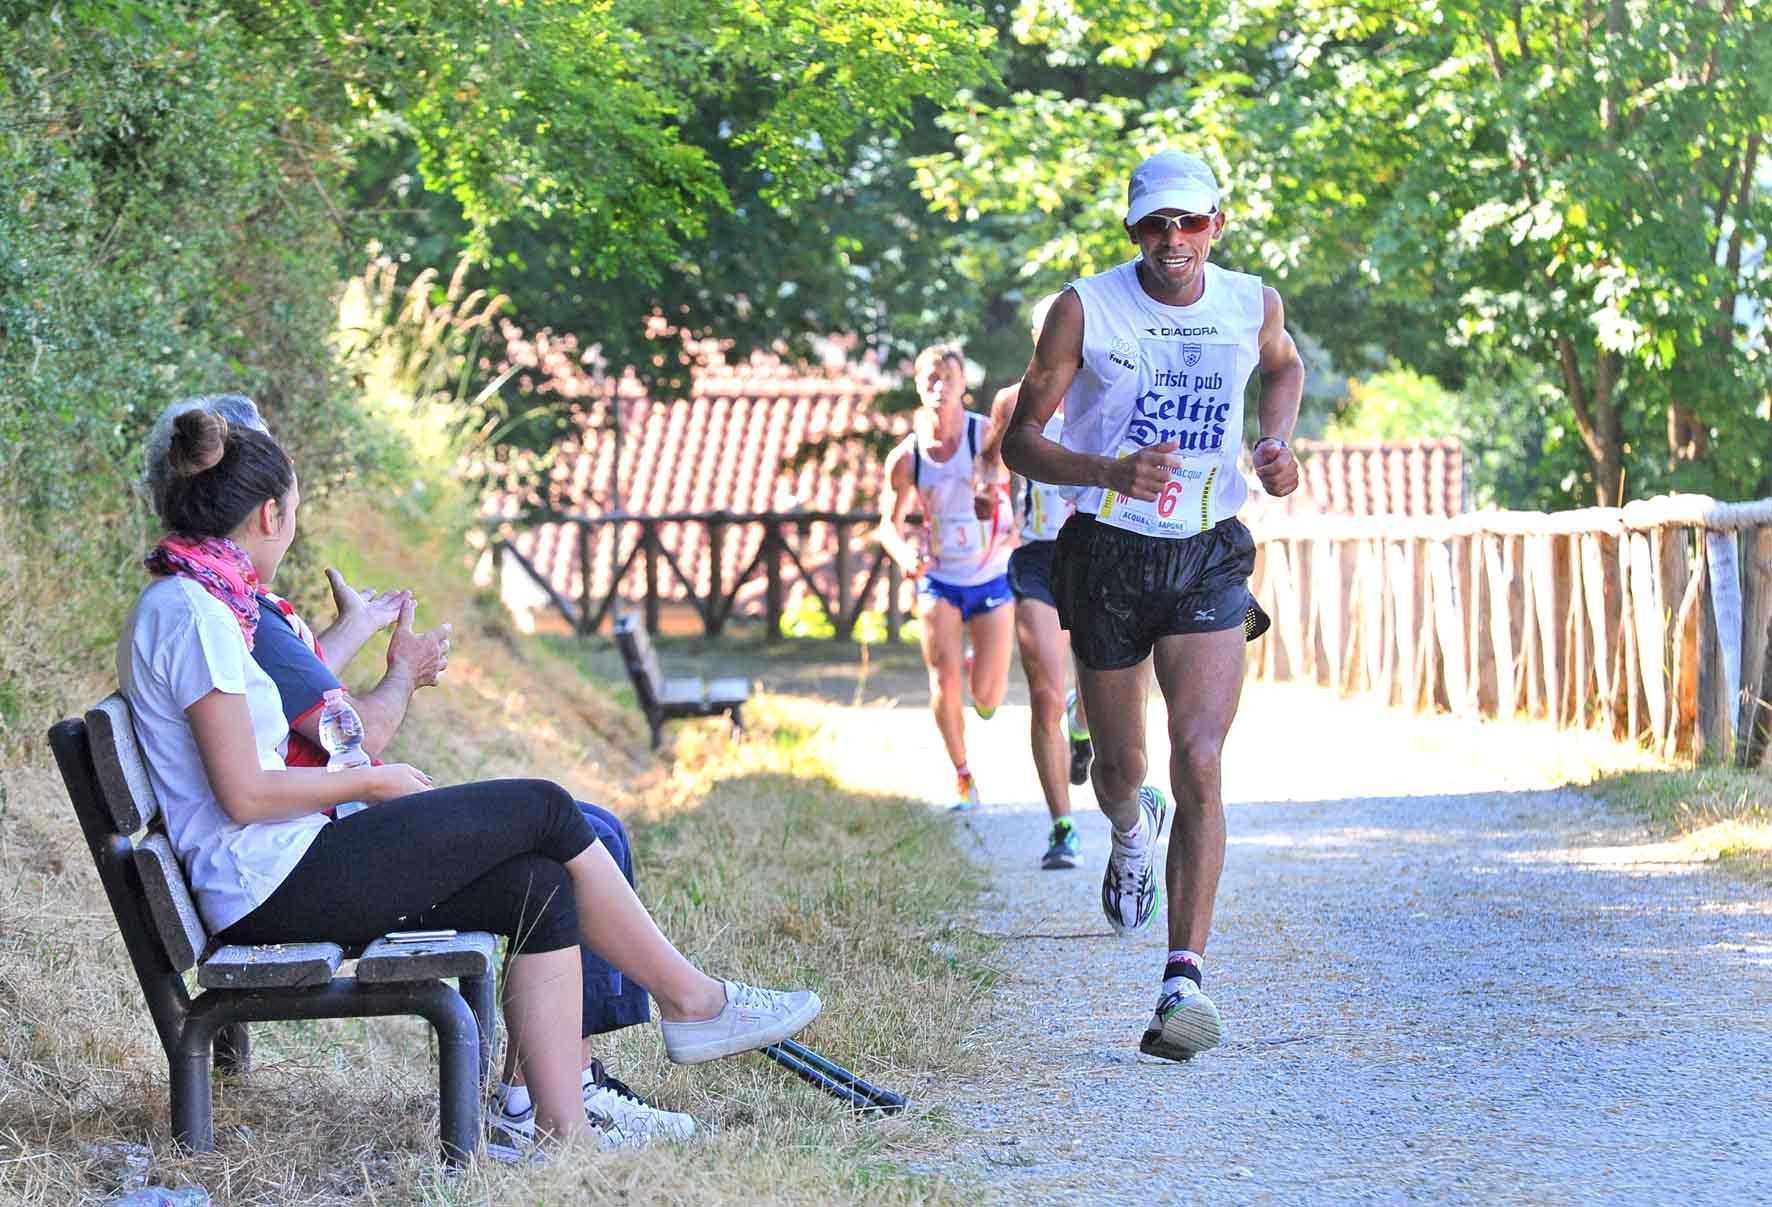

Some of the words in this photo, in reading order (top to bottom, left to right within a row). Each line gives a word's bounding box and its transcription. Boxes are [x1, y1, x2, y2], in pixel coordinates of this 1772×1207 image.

[1161, 327, 1218, 336] DIADORA
[1154, 369, 1188, 388] irish
[1194, 371, 1223, 392] pub
[1136, 390, 1230, 423] Celtic
[1126, 419, 1225, 451] Druid
[1157, 481, 1183, 518] 6
[1122, 511, 1145, 523] ACQUA
